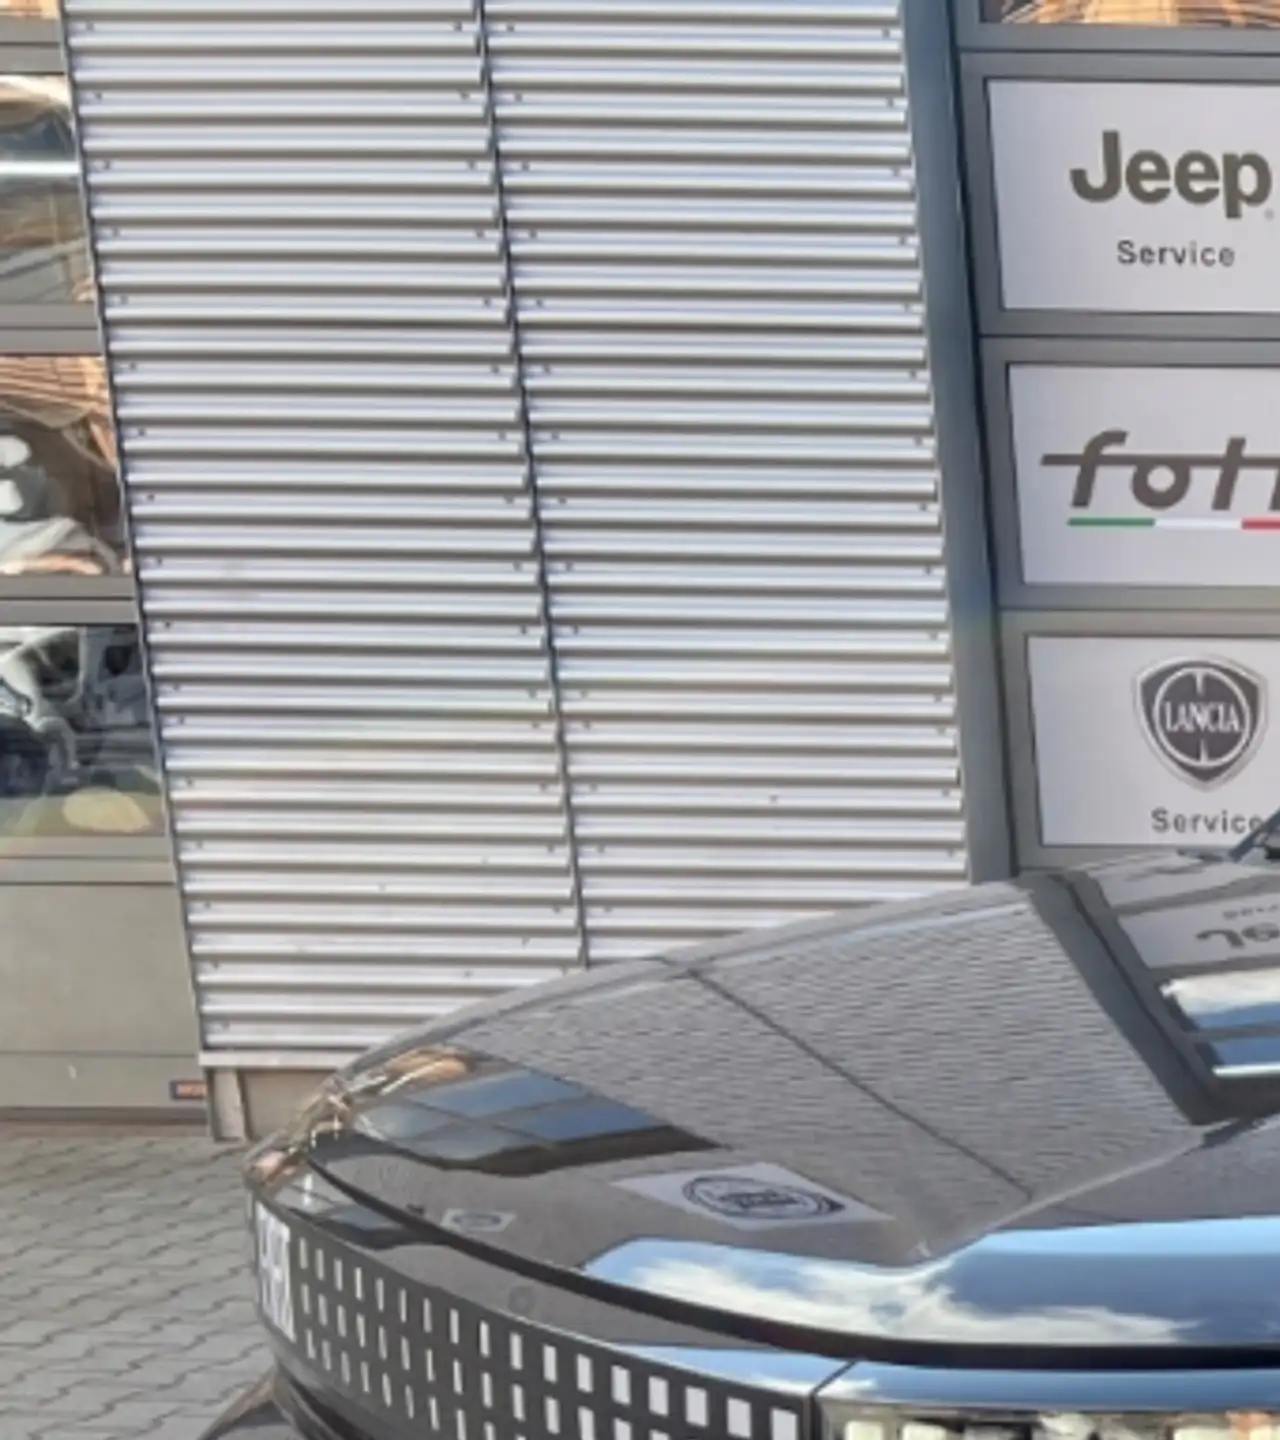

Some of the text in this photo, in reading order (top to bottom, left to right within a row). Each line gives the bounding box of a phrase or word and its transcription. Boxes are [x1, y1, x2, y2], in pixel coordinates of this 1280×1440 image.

[1070, 130, 1272, 220] Jeep
[1117, 240, 1235, 267] Service
[1164, 701, 1241, 733] LANCIA
